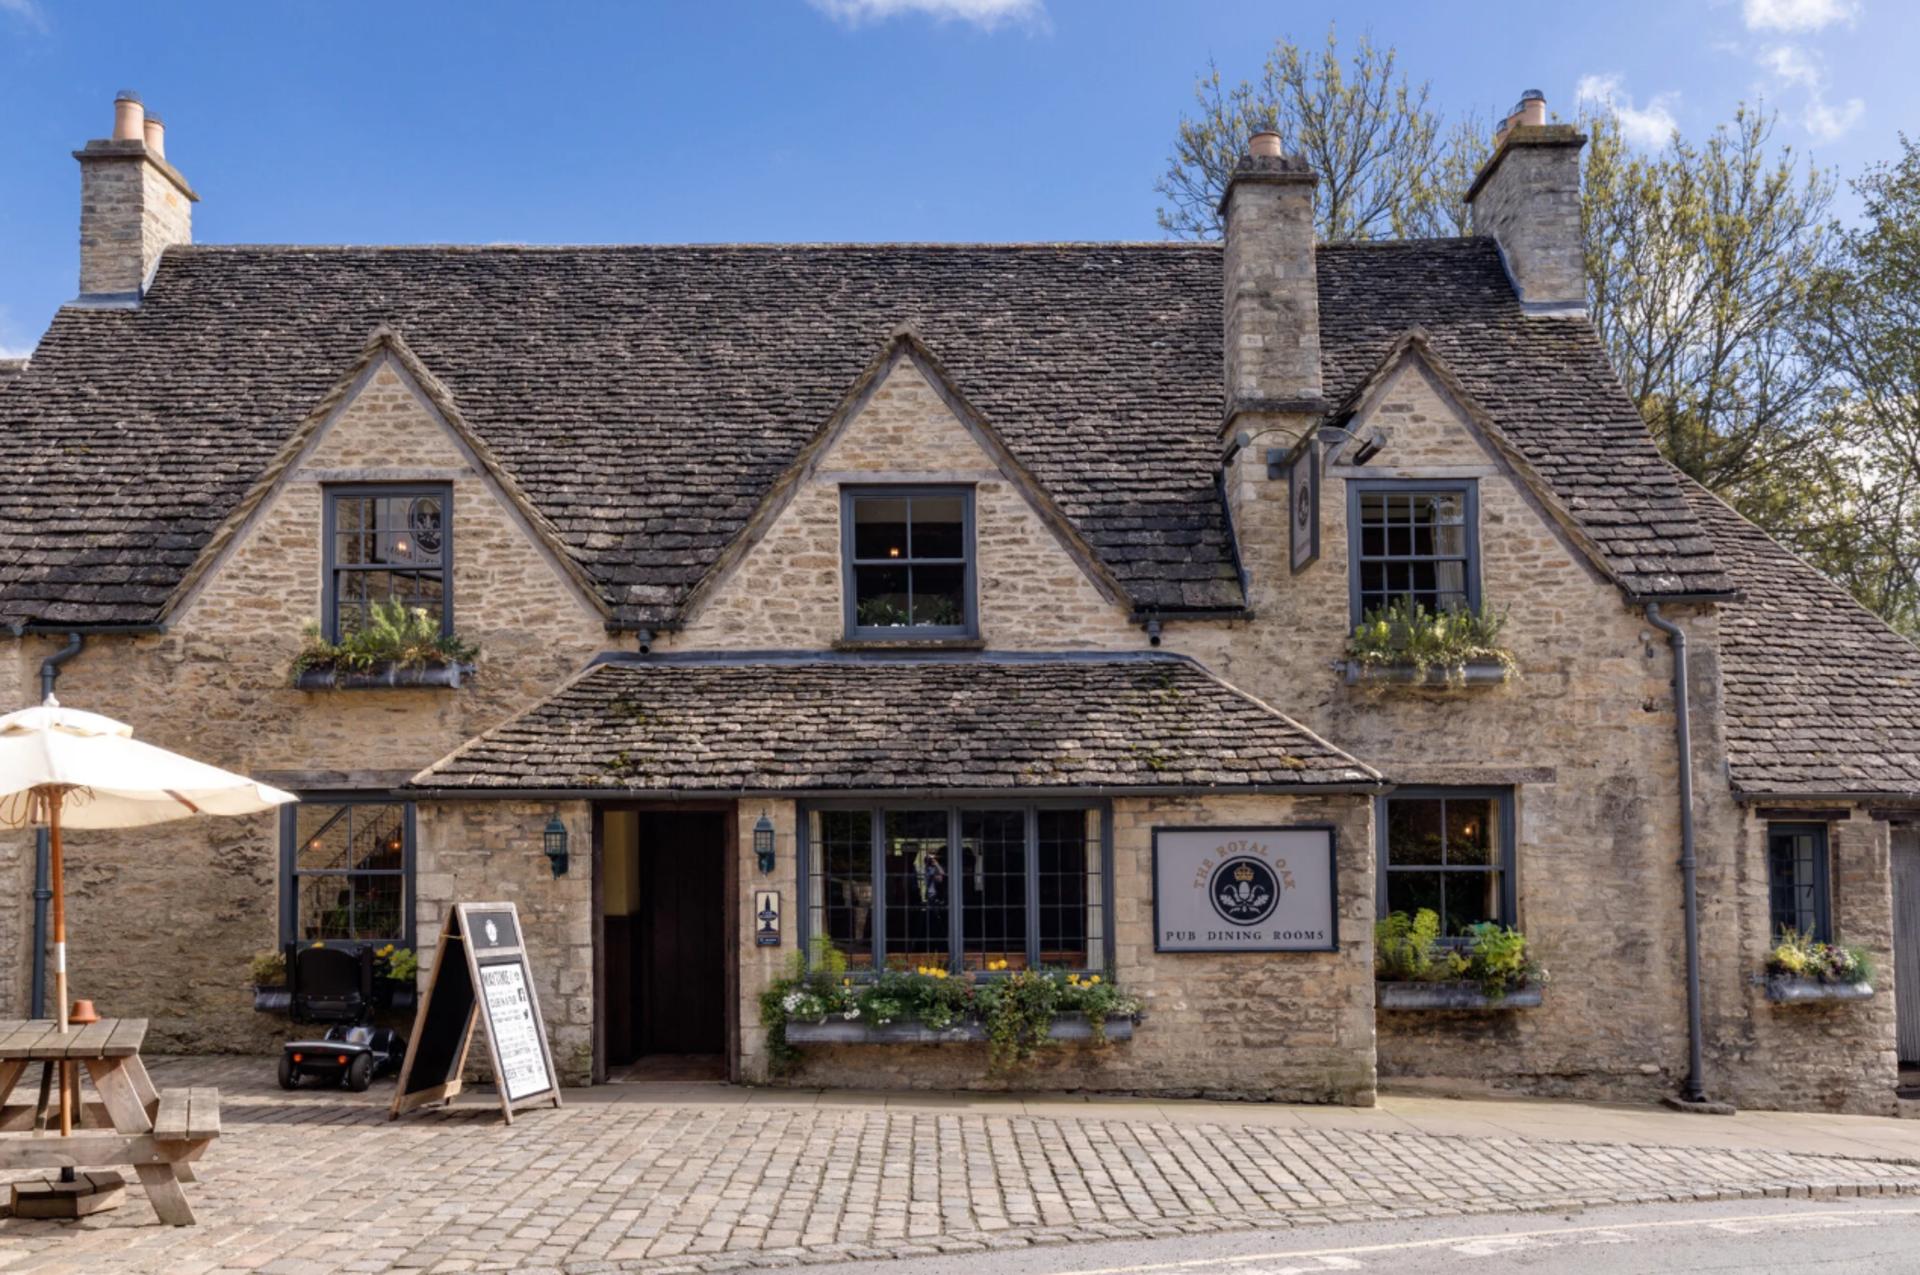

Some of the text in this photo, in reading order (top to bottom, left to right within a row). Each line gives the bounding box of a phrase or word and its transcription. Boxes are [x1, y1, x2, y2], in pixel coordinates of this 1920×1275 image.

[1193, 840, 1296, 890] THE ROYAL OAK
[1166, 930, 1324, 941] PUB DINING ROOMS
